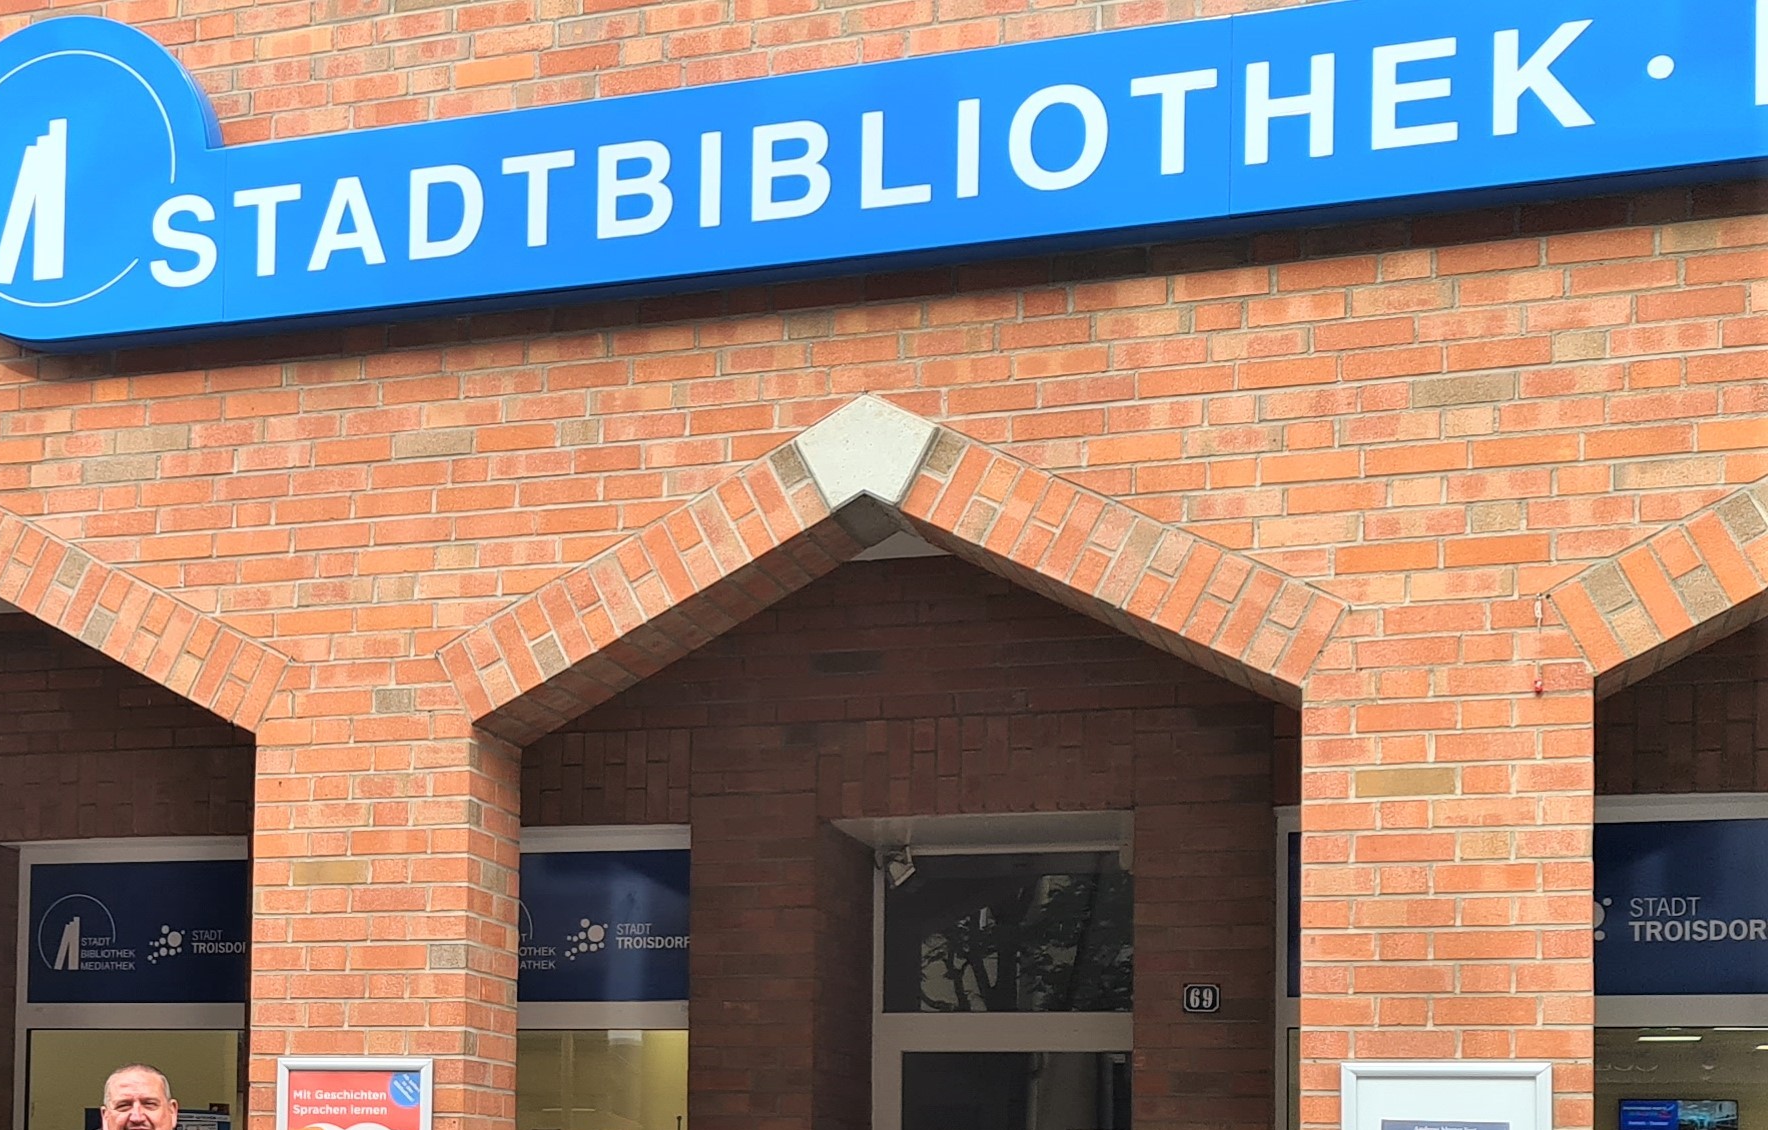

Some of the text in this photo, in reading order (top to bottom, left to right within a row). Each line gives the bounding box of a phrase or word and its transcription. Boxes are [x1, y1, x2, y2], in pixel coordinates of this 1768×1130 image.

[149, 19, 1595, 289] STADTBIBLIOTHEK
[1629, 896, 1701, 918] STADT
[616, 923, 652, 935] STADT
[1628, 919, 1767, 942] TROISDOR
[192, 930, 223, 941] STADT
[81, 937, 111, 946] STADT
[191, 942, 246, 954] TROISDO
[518, 946, 557, 957] OTHEK
[80, 949, 136, 959] BIBLIOTHEK
[80, 961, 136, 970] MEDIATHEK
[519, 960, 557, 970] ATHEK
[1189, 987, 1214, 1009] 69
[293, 1089, 387, 1100] Mit Geschichten
[292, 1105, 388, 1116] Sprachen lernen
